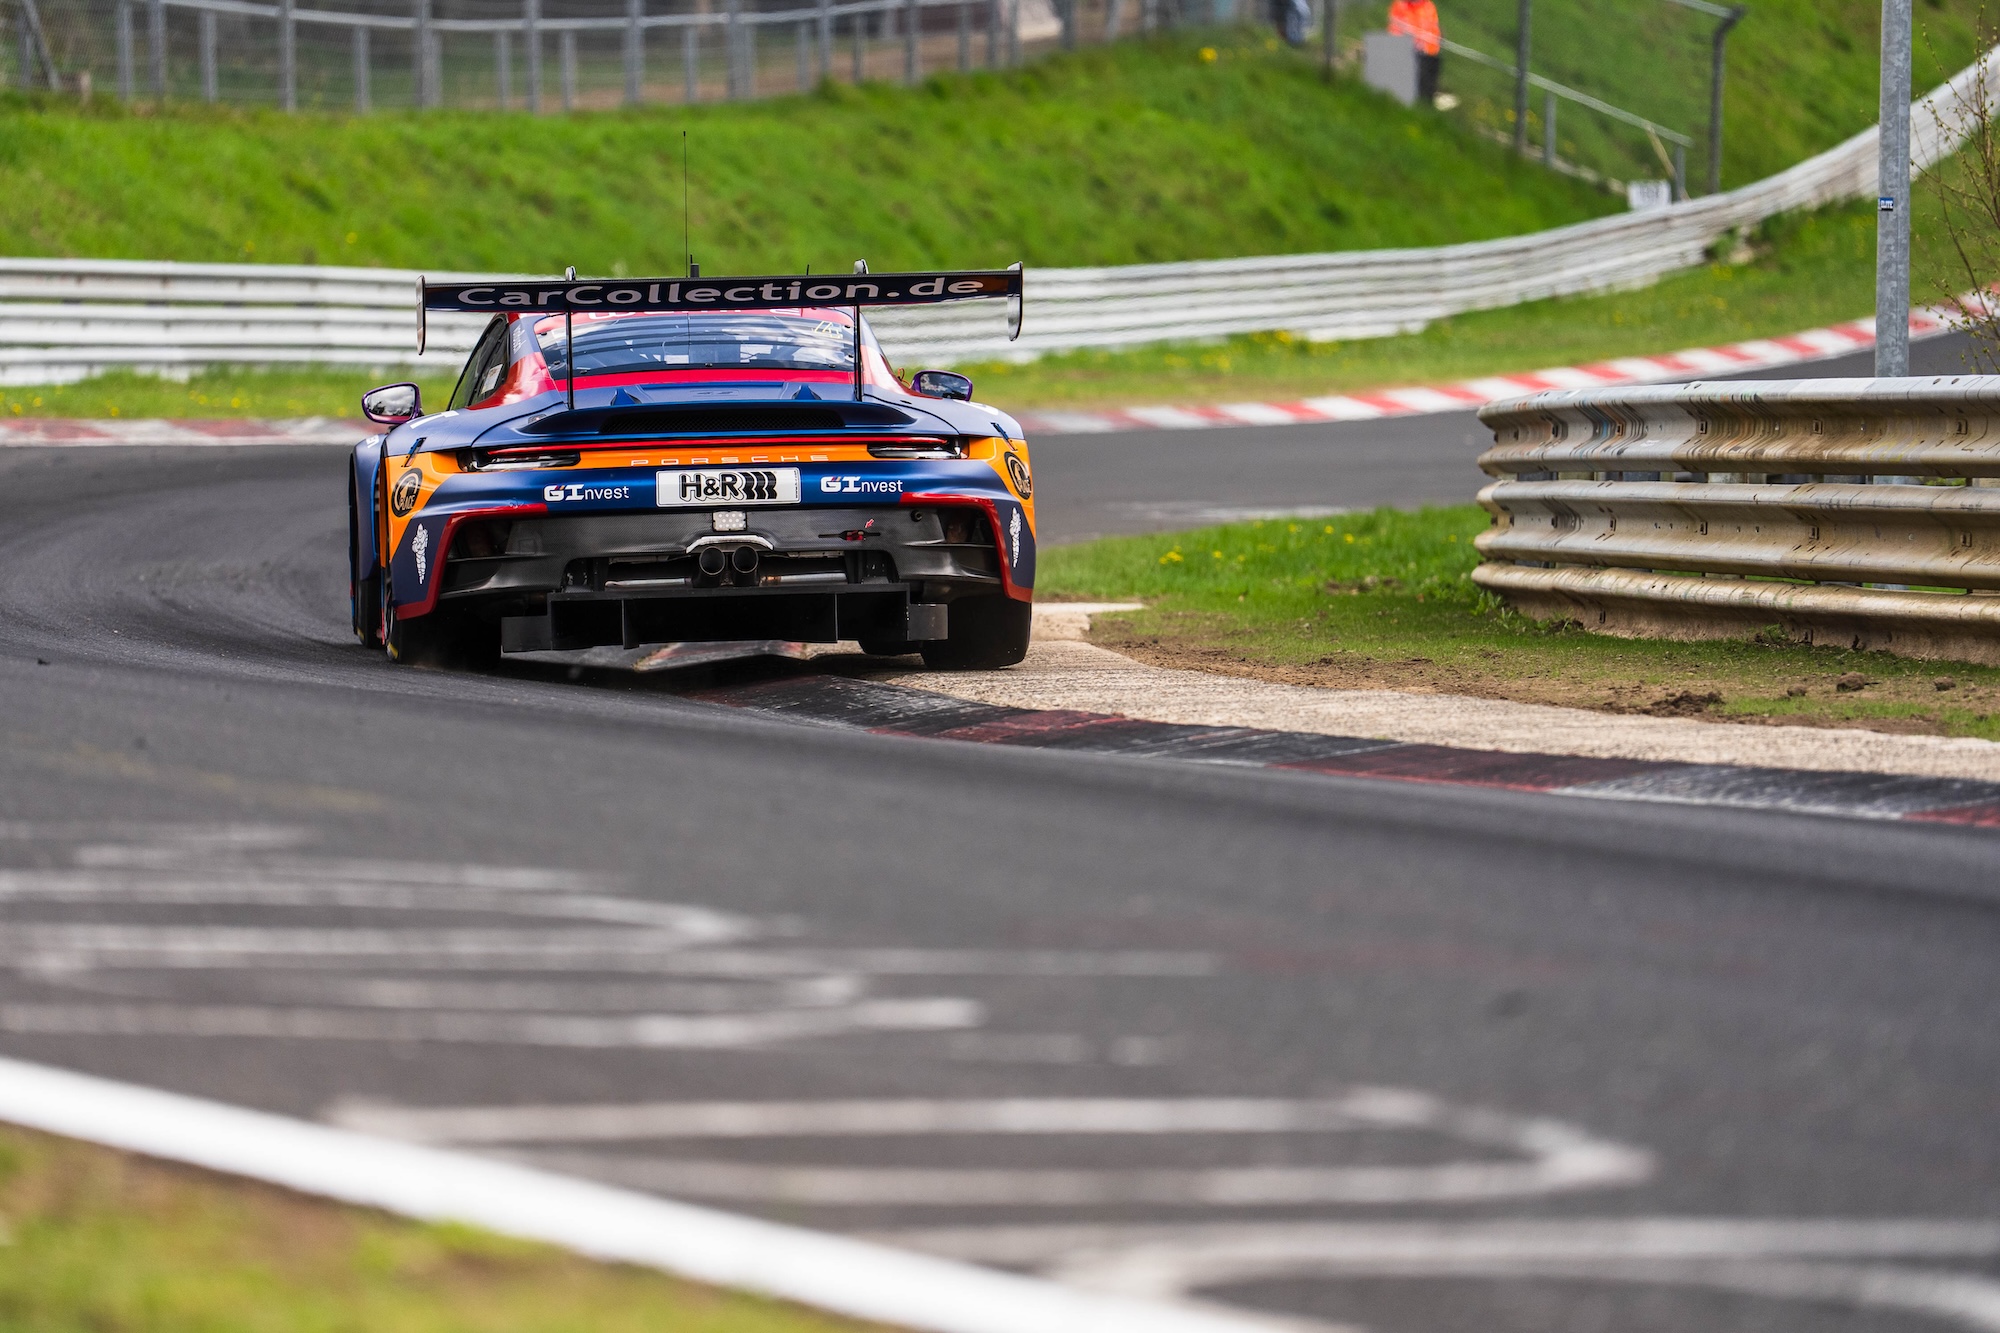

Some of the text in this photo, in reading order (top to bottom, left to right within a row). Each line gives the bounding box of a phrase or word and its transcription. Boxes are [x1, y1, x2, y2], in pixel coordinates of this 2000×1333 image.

[457, 277, 984, 305] CarCollection.de
[631, 455, 829, 467] PORSCHE
[680, 473, 743, 501] H&R
